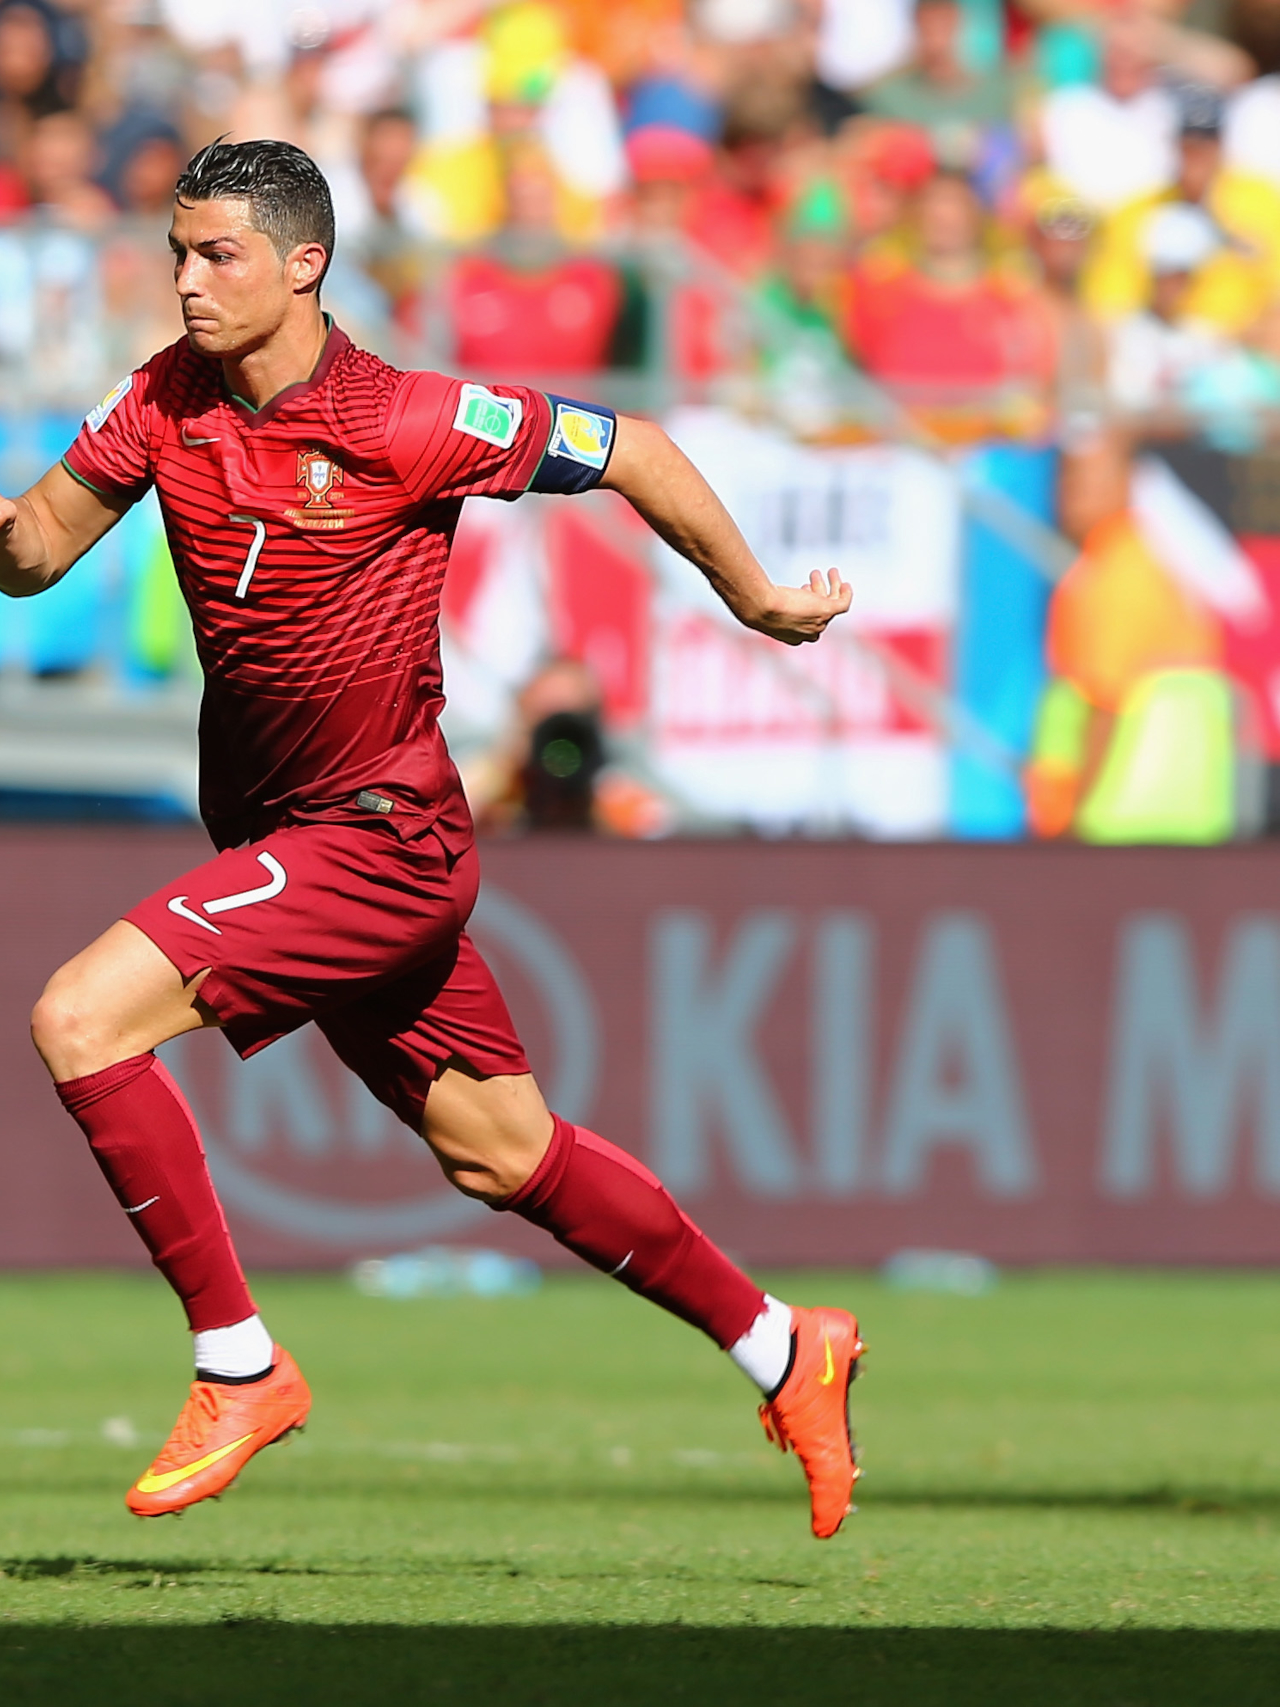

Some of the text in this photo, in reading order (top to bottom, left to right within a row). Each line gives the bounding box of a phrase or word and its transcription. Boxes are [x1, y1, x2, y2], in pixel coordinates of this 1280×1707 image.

[228, 513, 266, 599] 7
[202, 850, 287, 914] 7
[651, 914, 1034, 1195] KIA
